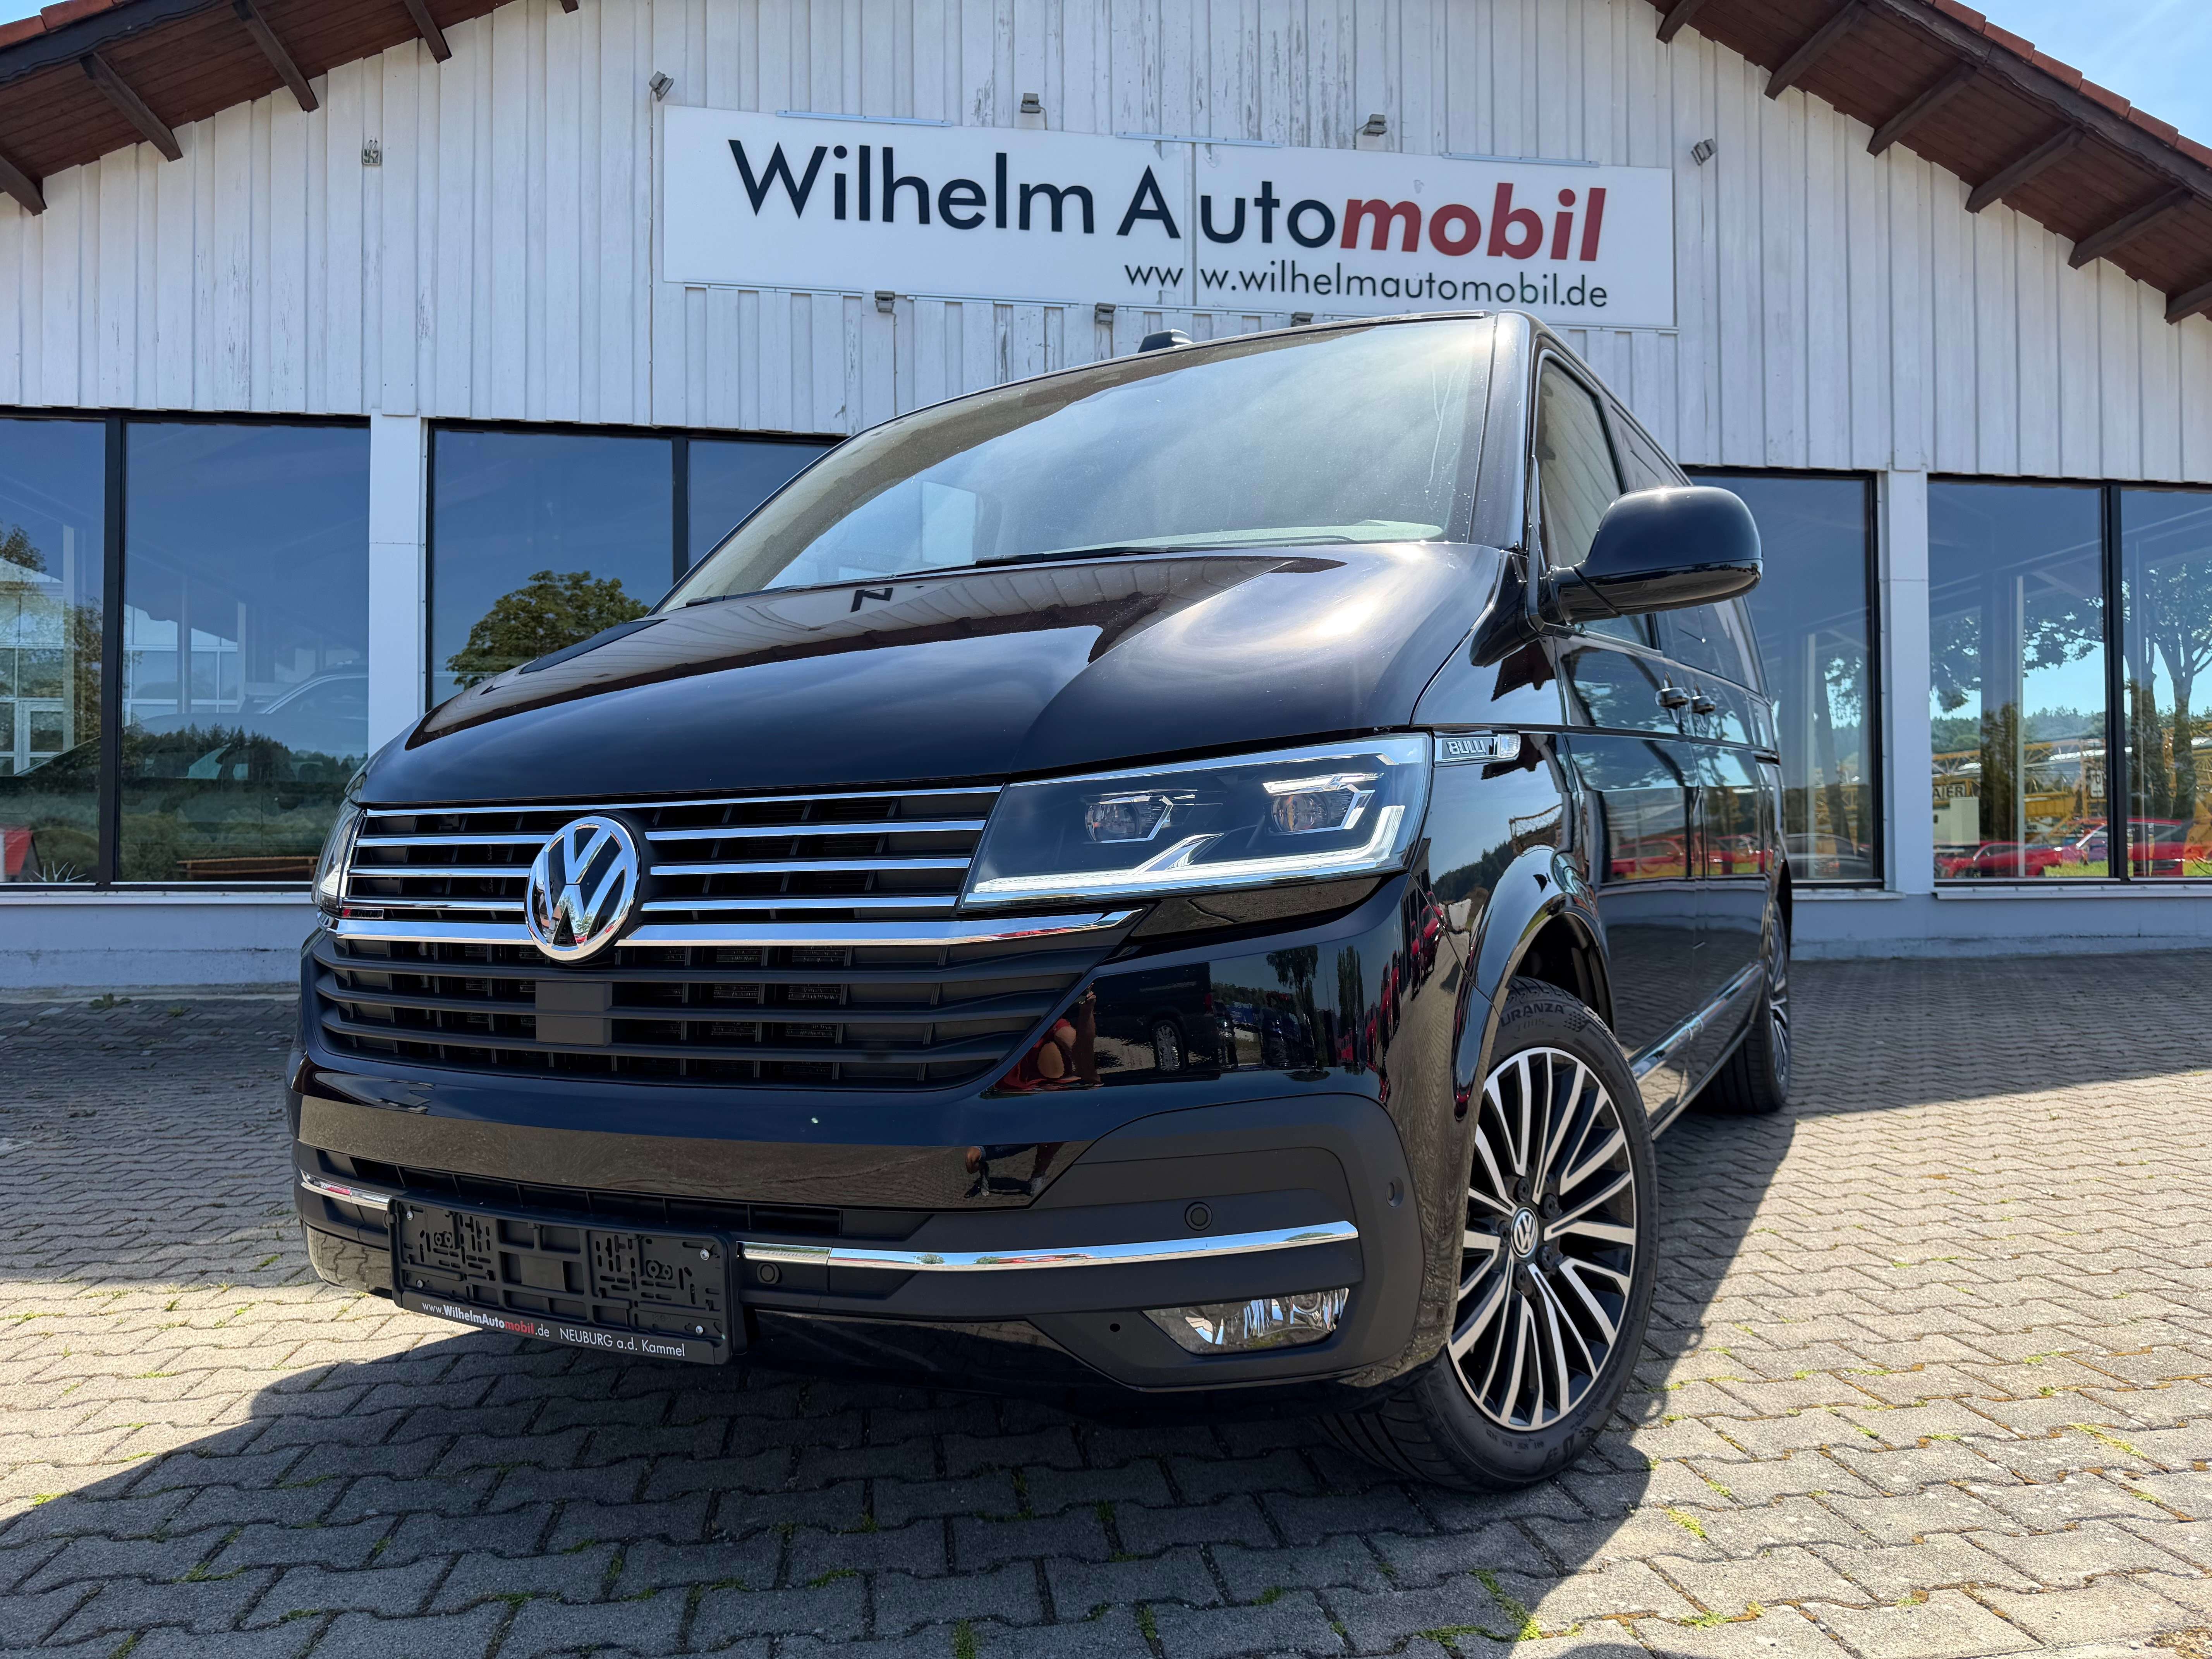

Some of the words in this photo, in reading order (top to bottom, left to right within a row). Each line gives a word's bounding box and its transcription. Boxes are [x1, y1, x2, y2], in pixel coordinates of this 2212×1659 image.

[727, 139, 1095, 234] Wilhelm
[1116, 164, 1607, 262] Automobil
[1124, 259, 1607, 308] www.wilhelmautomobil.de
[1446, 740, 1486, 755] BULLI
[1500, 1003, 1564, 1027] URANZA
[422, 1302, 550, 1337] www.WilhelmAutomobil.de
[560, 1328, 613, 1347] NEUBURG
[617, 1337, 638, 1351] a.d.
[642, 1339, 685, 1357] Kammel
